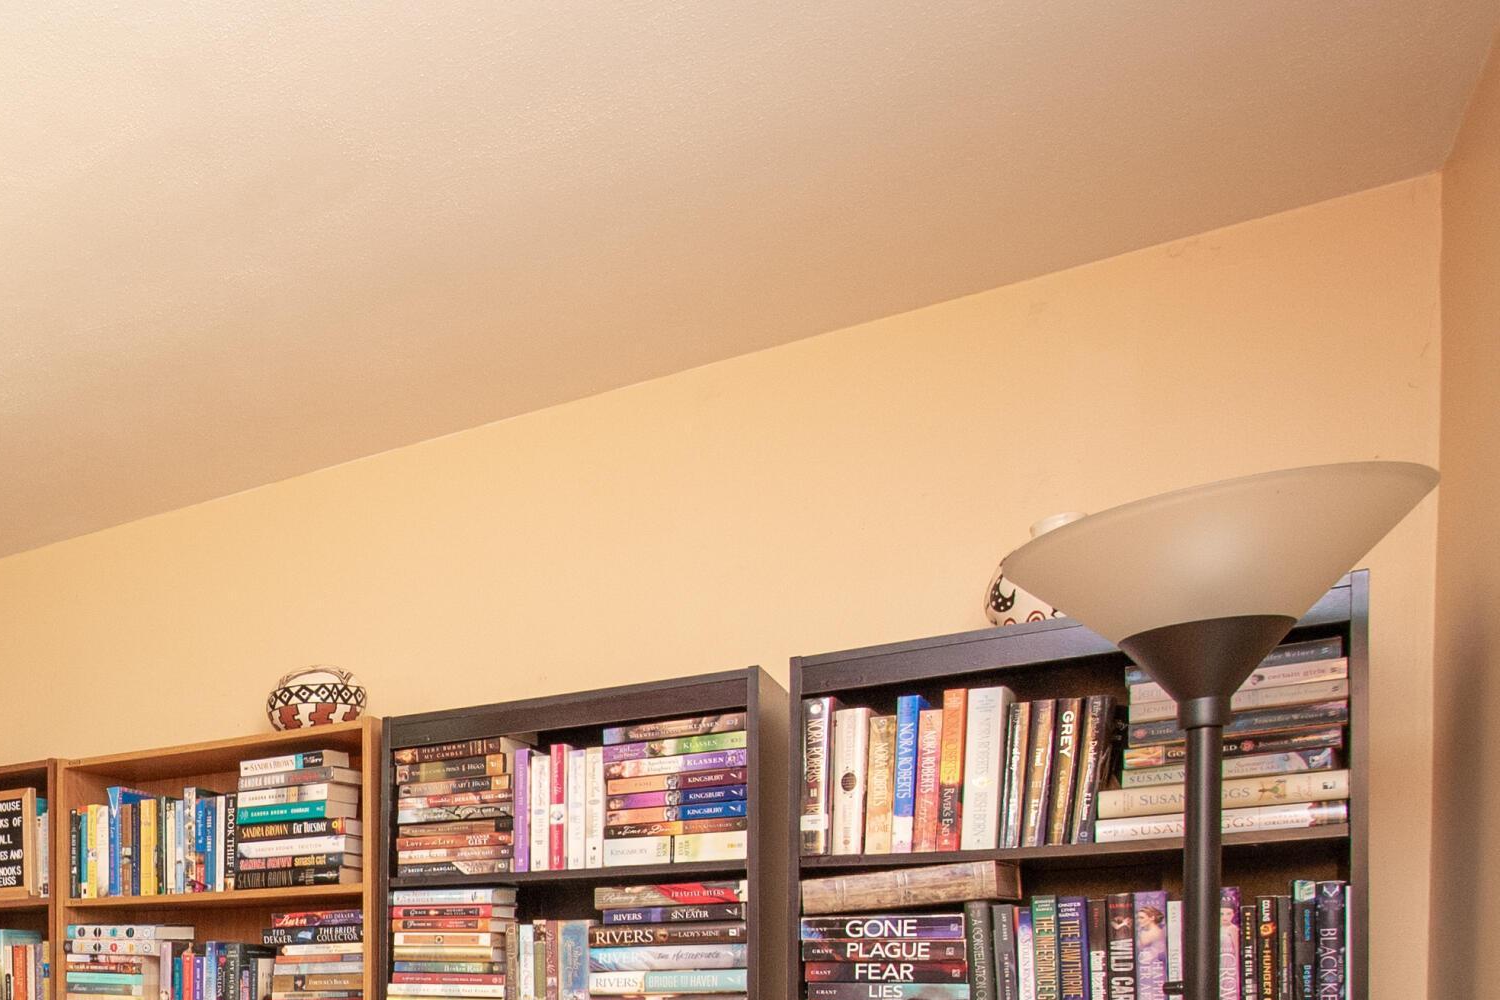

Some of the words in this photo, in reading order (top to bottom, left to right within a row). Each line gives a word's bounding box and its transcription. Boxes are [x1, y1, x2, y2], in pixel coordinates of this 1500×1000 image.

[899, 722, 915, 757] NORA
[1059, 710, 1075, 758] GREY
[922, 730, 938, 758] NORA
[687, 757, 724, 766] KLASSEN
[896, 760, 913, 799] ROBERTS
[920, 759, 935, 794] ROBERTS
[689, 791, 725, 800] KINGSBURY
[12, 816, 23, 828] OF
[227, 808, 235, 836] BOOK
[0, 834, 13, 845] ALL
[9, 848, 23, 860] AND
[227, 837, 235, 867] THIEF
[319, 927, 334, 935] THE
[334, 926, 357, 934] BRIDE
[845, 919, 918, 938] GONE
[1035, 915, 1055, 933] THE
[1059, 919, 1080, 938] THE
[263, 935, 293, 945] DEKKER
[316, 932, 359, 942] COLLECTOR
[846, 942, 931, 959] PLAGUE
[1110, 938, 1133, 972] WILD
[1320, 928, 1337, 978] BLACK
[855, 963, 914, 980] FEAR
[1036, 934, 1056, 992] INHERITANCE
[1060, 939, 1083, 1000] HAWTHORNE
[1263, 950, 1272, 995] HUNGER
[868, 985, 903, 998] LIES
